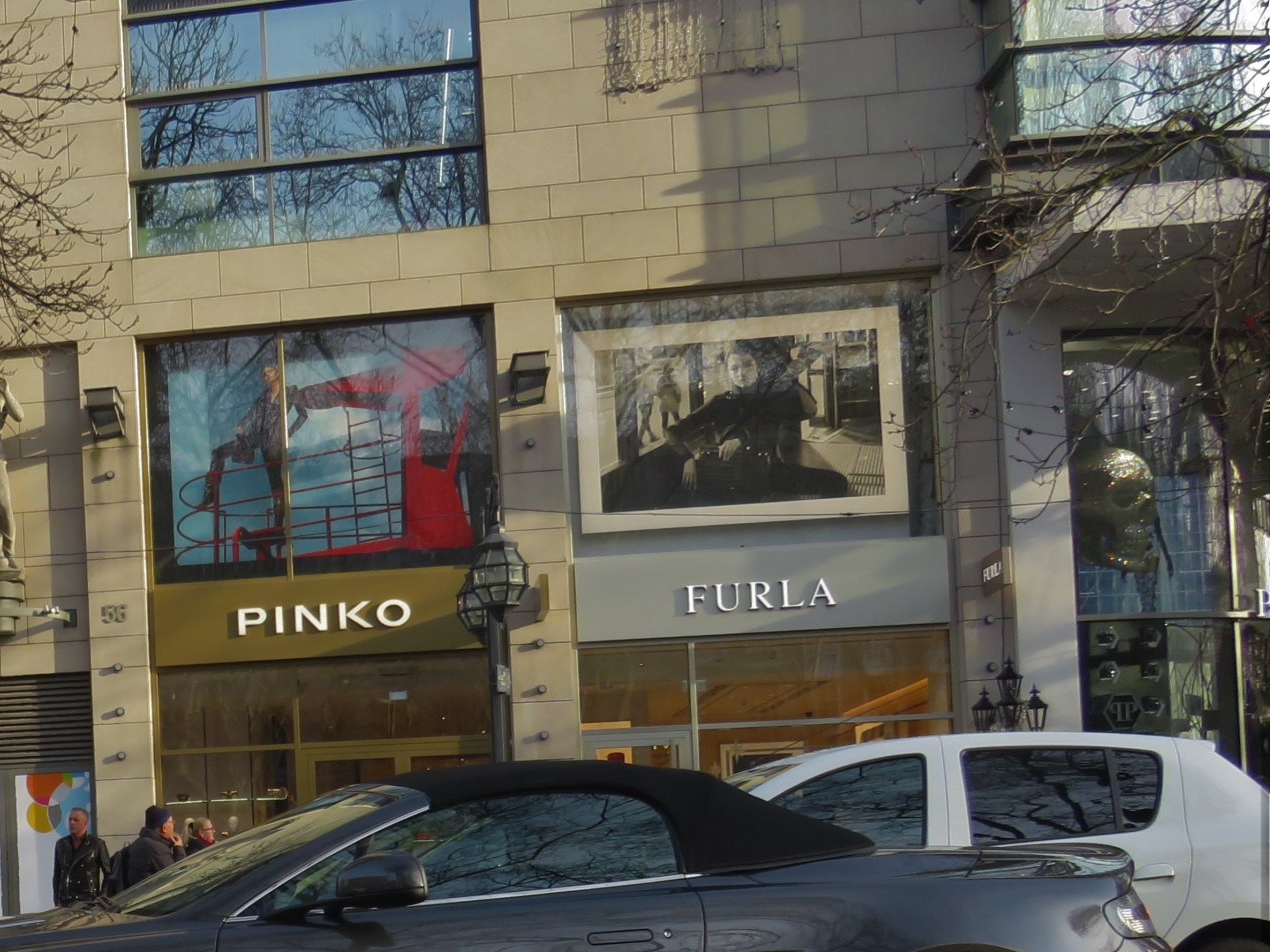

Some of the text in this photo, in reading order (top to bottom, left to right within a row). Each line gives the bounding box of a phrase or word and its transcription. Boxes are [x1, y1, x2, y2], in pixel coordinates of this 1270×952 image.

[100, 604, 128, 624] 56
[685, 577, 837, 614] FURLA
[238, 599, 411, 636] PINKO
